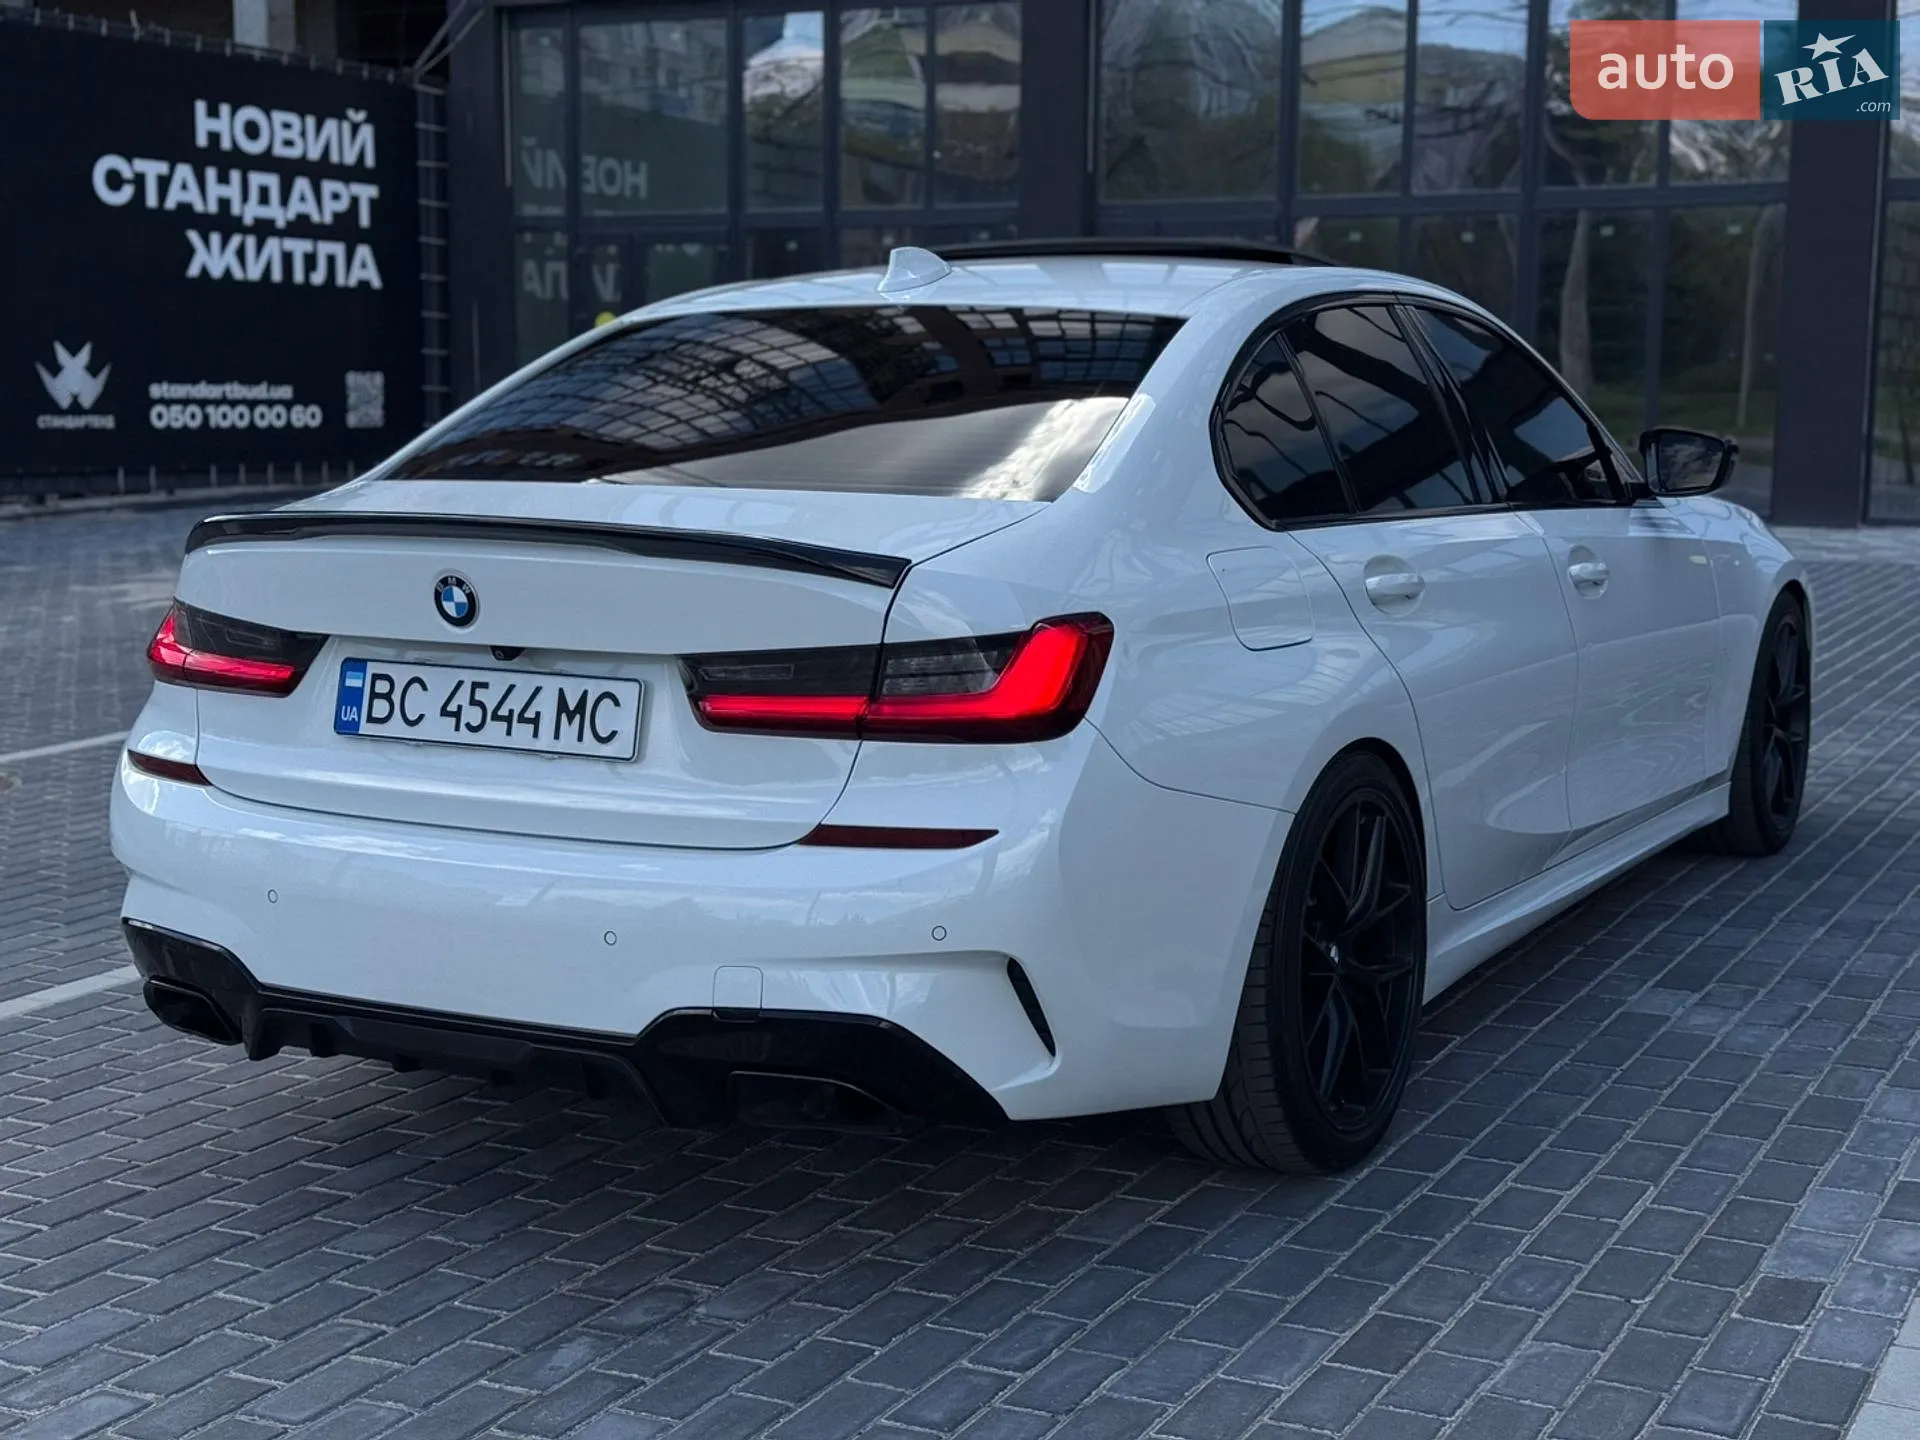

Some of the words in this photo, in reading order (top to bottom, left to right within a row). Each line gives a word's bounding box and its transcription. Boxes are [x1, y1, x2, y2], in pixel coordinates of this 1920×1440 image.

[194, 99, 375, 168] НОВИЙ
[92, 154, 379, 228] СТАНДАРТ
[186, 230, 382, 289] ЖИТЛА
[150, 403, 202, 429] 050
[205, 404, 250, 429] 100
[253, 404, 287, 428] 00
[436, 577, 471, 594] BMW
[341, 706, 359, 722] UA
[366, 673, 428, 727] BC
[439, 680, 543, 739] 4544
[553, 687, 621, 744] MC
